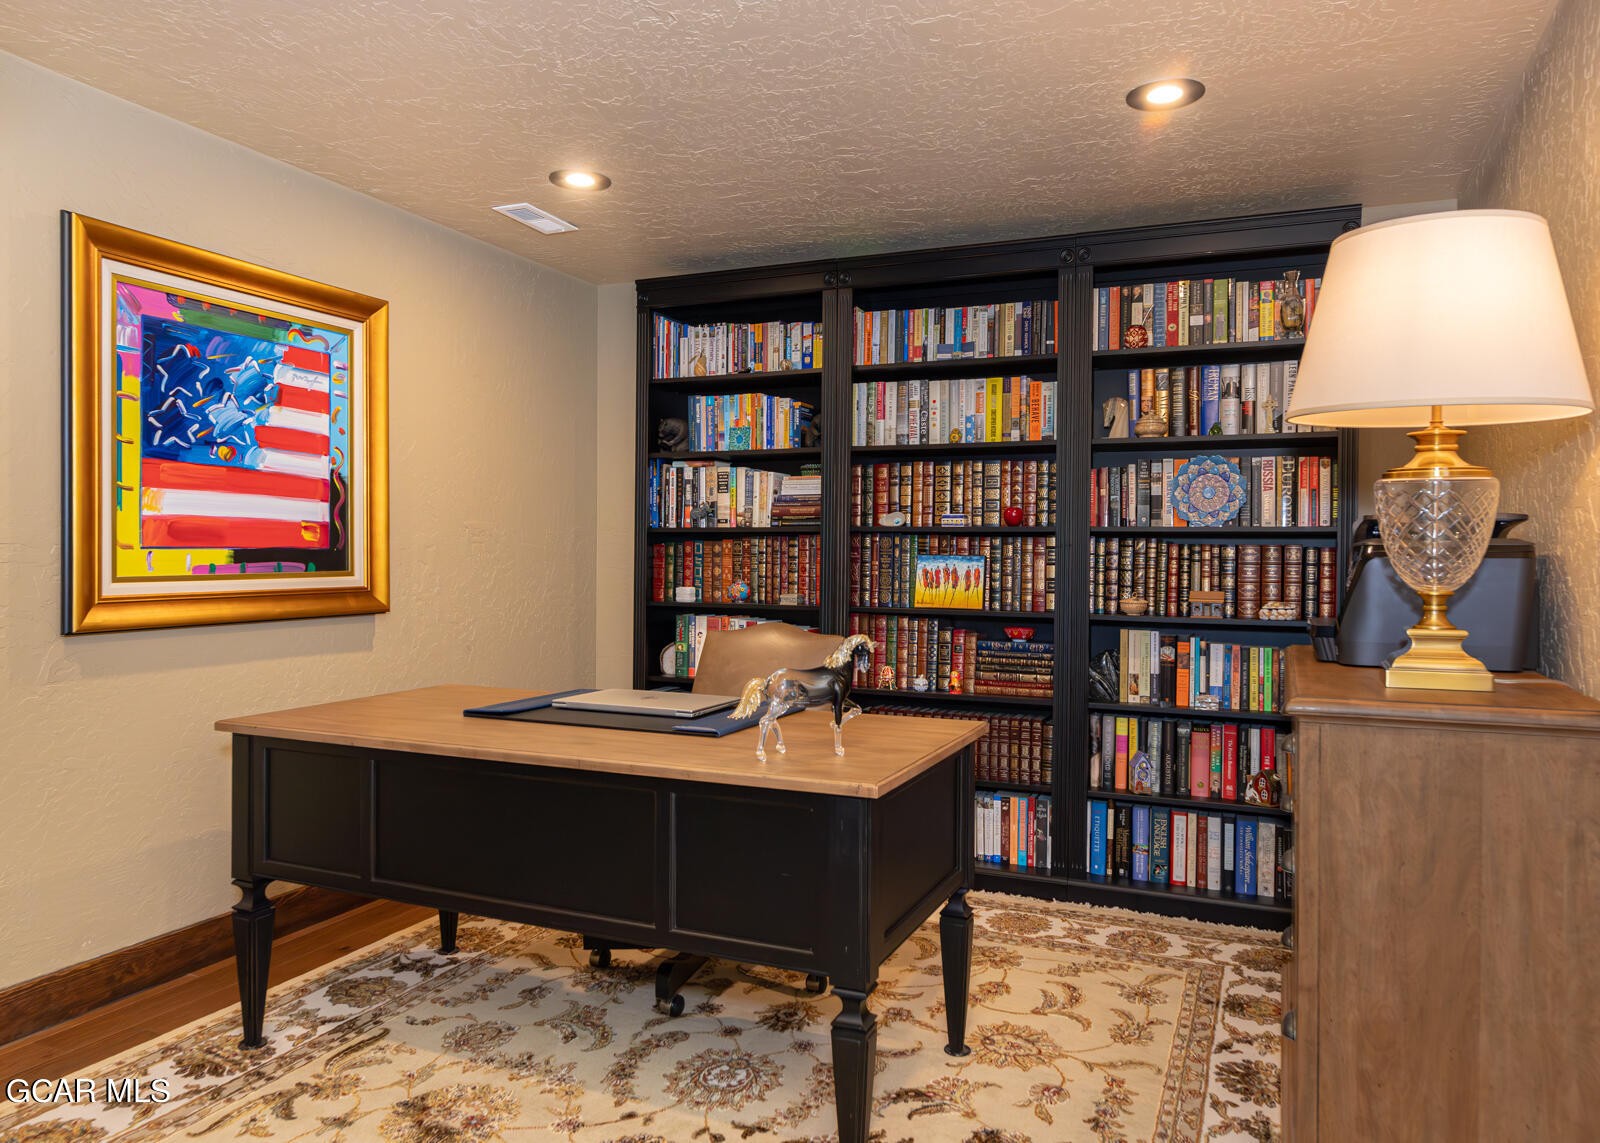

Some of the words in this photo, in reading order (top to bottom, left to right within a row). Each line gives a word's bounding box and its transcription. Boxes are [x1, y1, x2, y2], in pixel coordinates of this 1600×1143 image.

[1208, 368, 1219, 401] TRUMAN
[1288, 363, 1297, 378] LEON
[909, 410, 918, 439] UPHEAVAL
[920, 410, 928, 435] Caste
[1031, 398, 1040, 424] BEHAVE
[1263, 459, 1273, 492] RUSSIA
[1281, 460, 1295, 527] EUROPE
[1245, 825, 1254, 849] William
[1242, 849, 1256, 884] Shakespeare
